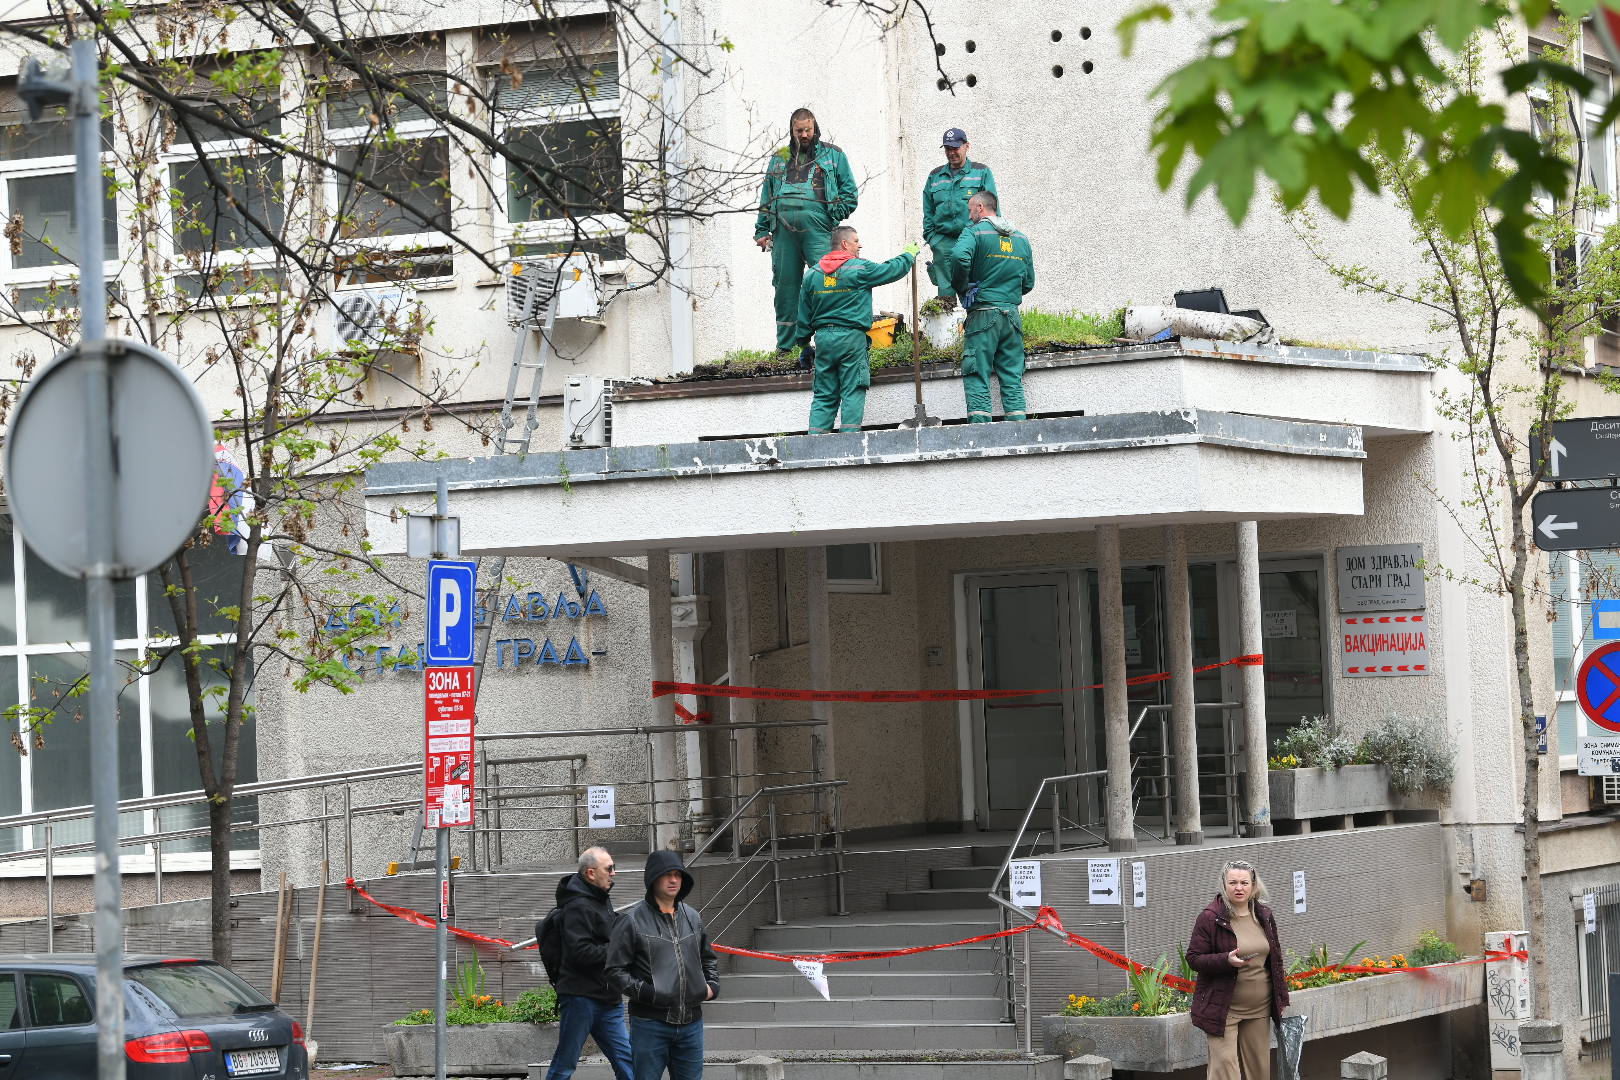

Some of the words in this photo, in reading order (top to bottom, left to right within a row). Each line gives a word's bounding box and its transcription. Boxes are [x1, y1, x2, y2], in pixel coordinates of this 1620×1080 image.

[1346, 556, 1366, 573] ДОМ
[1371, 554, 1415, 571] ЗДРАВЉА
[1352, 574, 1382, 590] СТАРИ
[1387, 573, 1411, 589] ГРАД
[439, 578, 461, 645] P
[1345, 632, 1426, 656] ВАКЦИНАЦИЈА
[429, 671, 460, 690] ЗОНА
[466, 671, 471, 690] 1
[231, 1054, 243, 1069] BG
